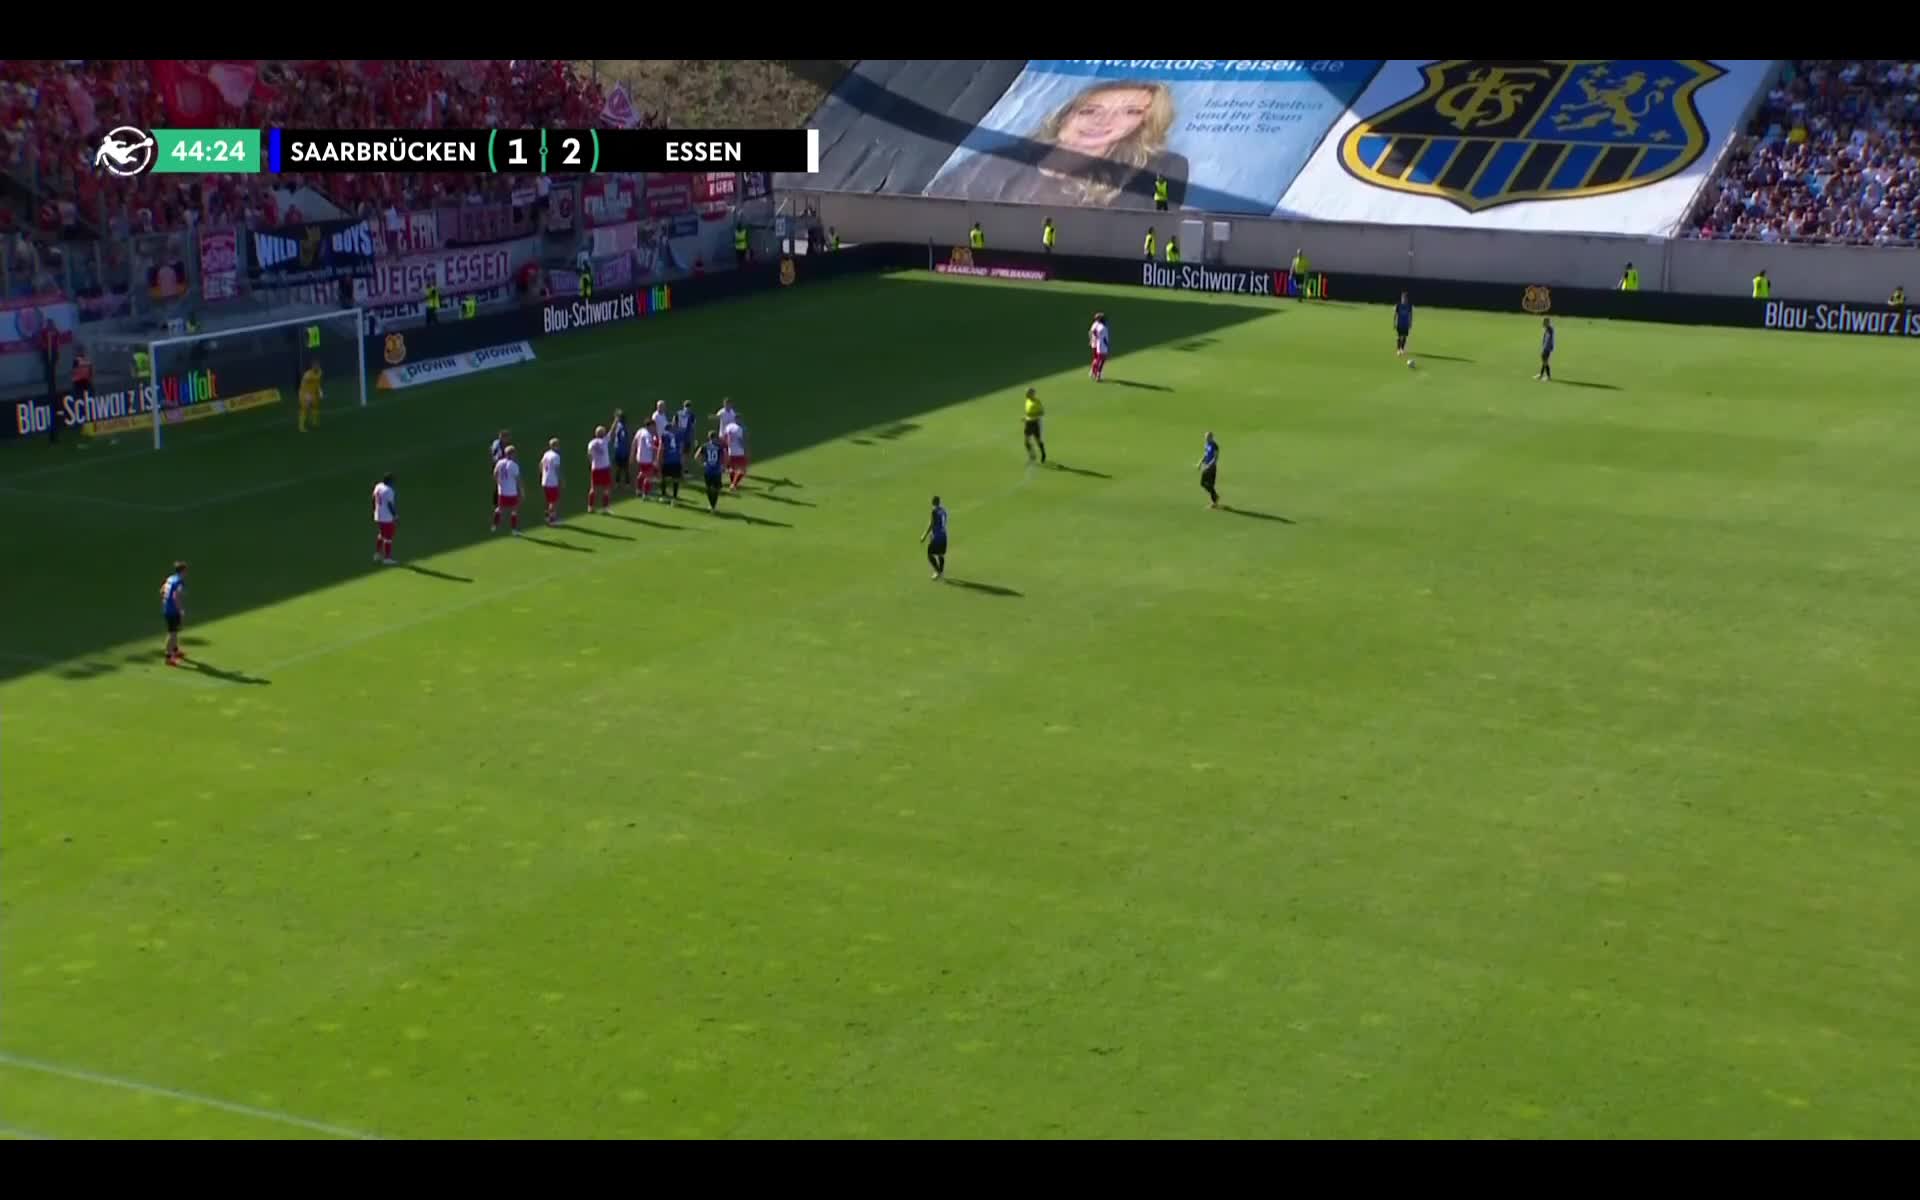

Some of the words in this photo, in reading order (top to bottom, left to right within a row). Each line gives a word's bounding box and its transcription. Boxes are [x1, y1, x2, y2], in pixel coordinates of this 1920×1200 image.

[1063, 60, 1344, 72] w.victors-reisen.de
[1185, 121, 1250, 134] beraten
[1194, 110, 1228, 121] und
[253, 231, 298, 270] WILD
[332, 220, 373, 257] BOYS
[445, 251, 508, 287] ESSEN
[1143, 263, 1246, 293] Blau-Schwarz
[1249, 270, 1269, 294] ist
[1273, 271, 1328, 299] Viealt
[544, 297, 619, 333] Blau-Schwarz
[620, 293, 635, 319] ist
[1765, 301, 1900, 334] Blau-Schwarz
